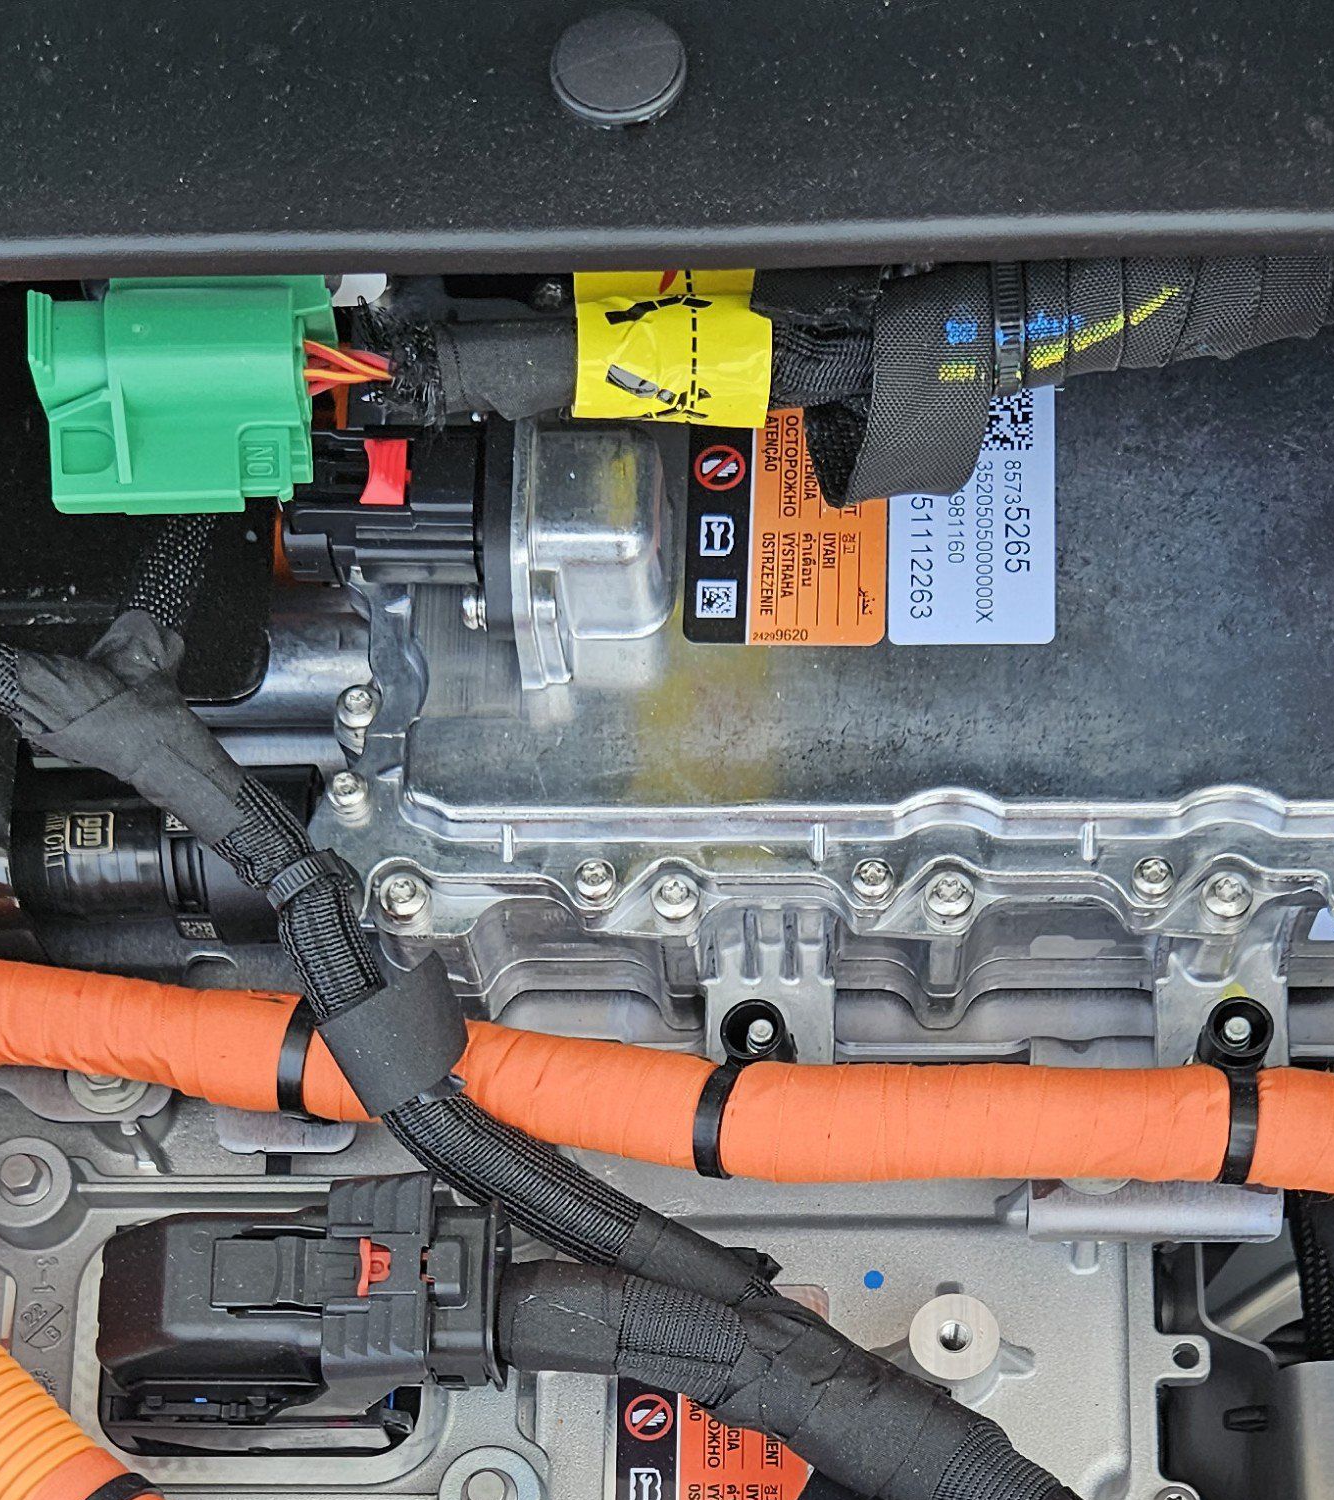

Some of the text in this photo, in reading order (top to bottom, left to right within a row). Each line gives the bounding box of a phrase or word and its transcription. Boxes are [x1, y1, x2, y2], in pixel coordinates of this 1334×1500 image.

[782, 414, 799, 518] ОСТОРОЖНО
[1004, 460, 1030, 574] 85735265
[779, 532, 799, 598] VÝSTRAHA
[821, 532, 836, 569] UYARI
[842, 532, 857, 555] 경고
[752, 629, 808, 642] 24299620
